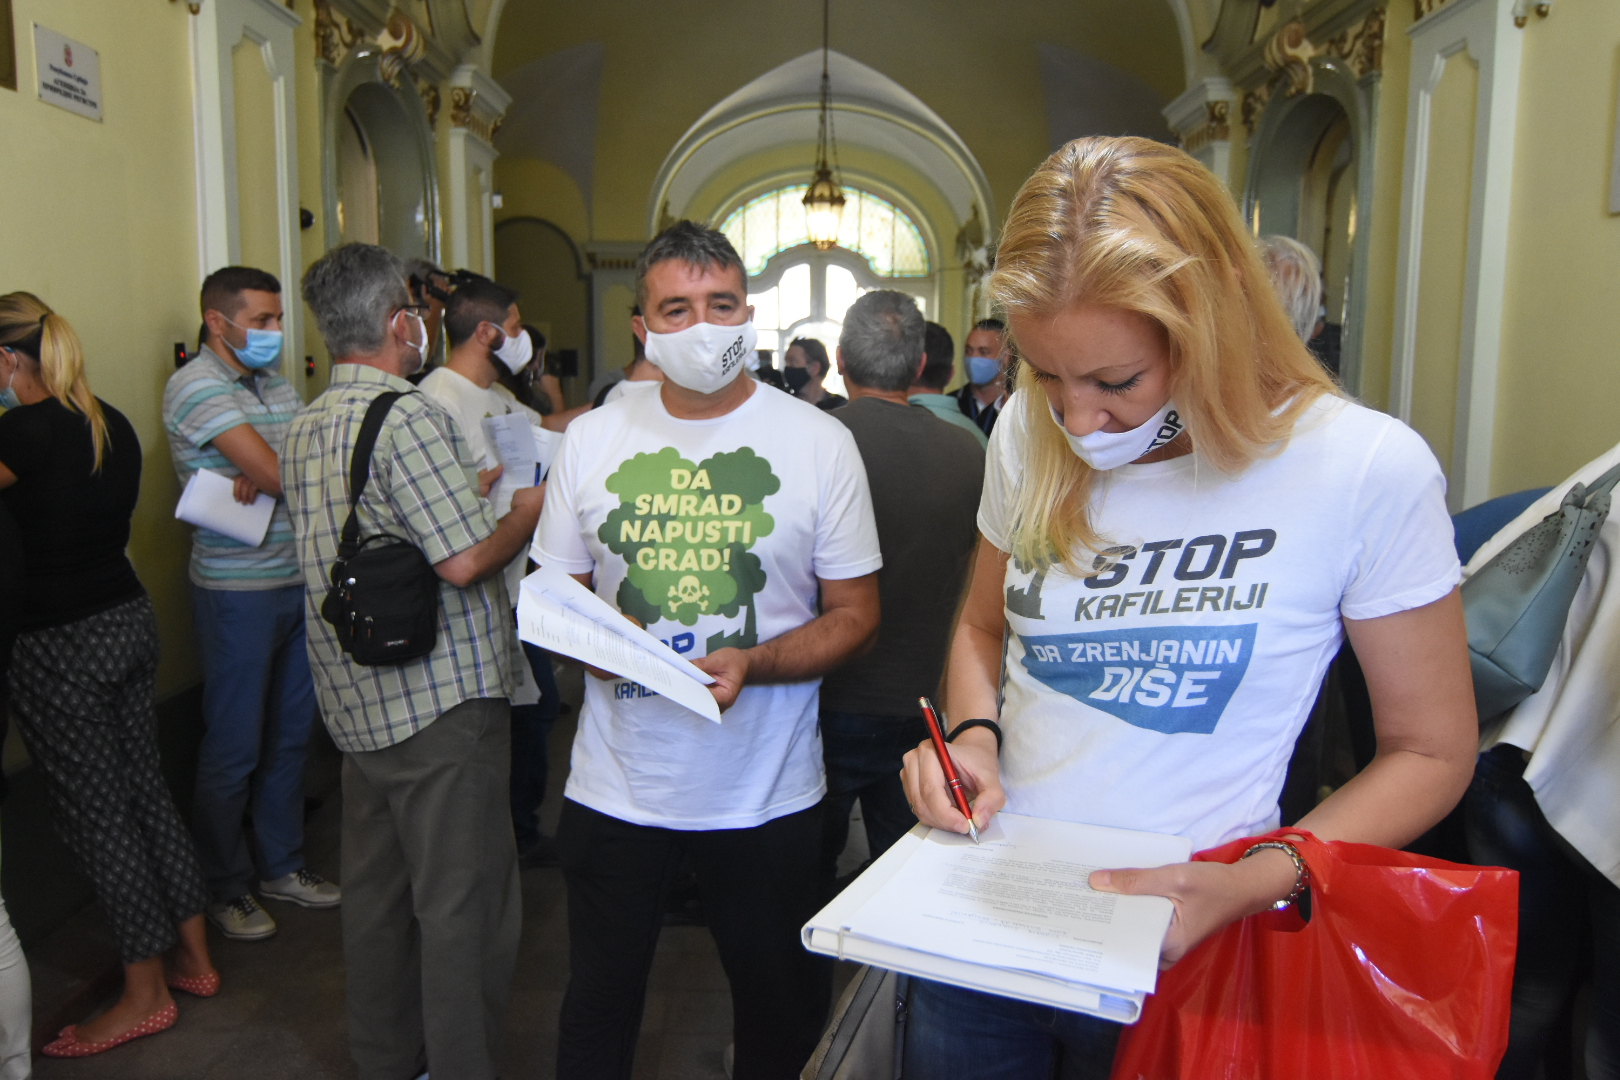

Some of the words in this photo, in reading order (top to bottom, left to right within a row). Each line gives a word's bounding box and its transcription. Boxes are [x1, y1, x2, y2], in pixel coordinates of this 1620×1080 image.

[722, 335, 744, 368] STOP
[1140, 410, 1183, 457] TOP
[670, 468, 712, 490] DA
[635, 493, 743, 517] SMRAD
[620, 520, 752, 544] NAPUSTI
[636, 547, 731, 572] GRAD!
[1083, 528, 1278, 590] STOP
[1074, 582, 1270, 622] KAFILERIJI
[1031, 644, 1063, 663] DA
[1067, 638, 1243, 665] ZRENJANIN
[614, 680, 661, 700] KAFIL
[1088, 663, 1222, 708] DIŠE
